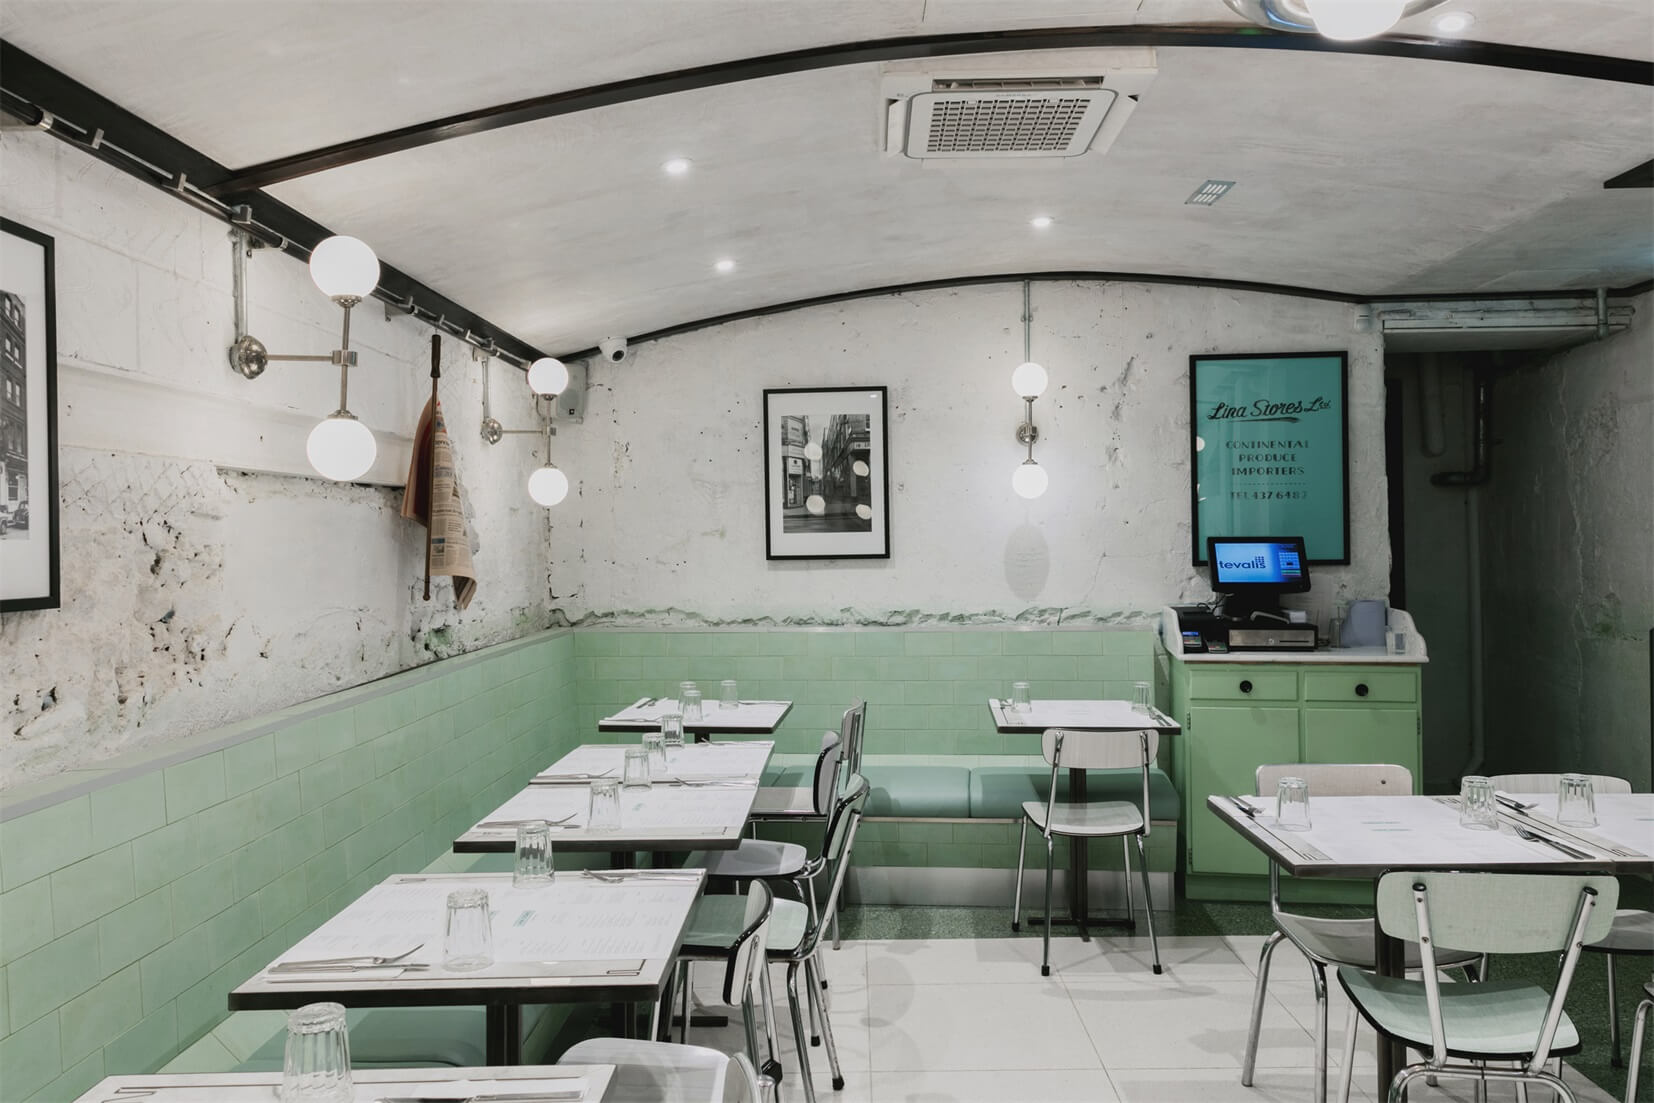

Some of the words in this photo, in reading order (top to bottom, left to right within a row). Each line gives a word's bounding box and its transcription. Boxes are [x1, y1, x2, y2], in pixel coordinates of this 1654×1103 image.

[1207, 402, 1248, 420] Lina
[1250, 399, 1303, 417] Stores
[1225, 440, 1309, 449] CONTINENTAL
[1239, 453, 1297, 462] PRODUCE
[1231, 466, 1305, 476] IMPORTERS
[1219, 558, 1266, 569] tevalis
